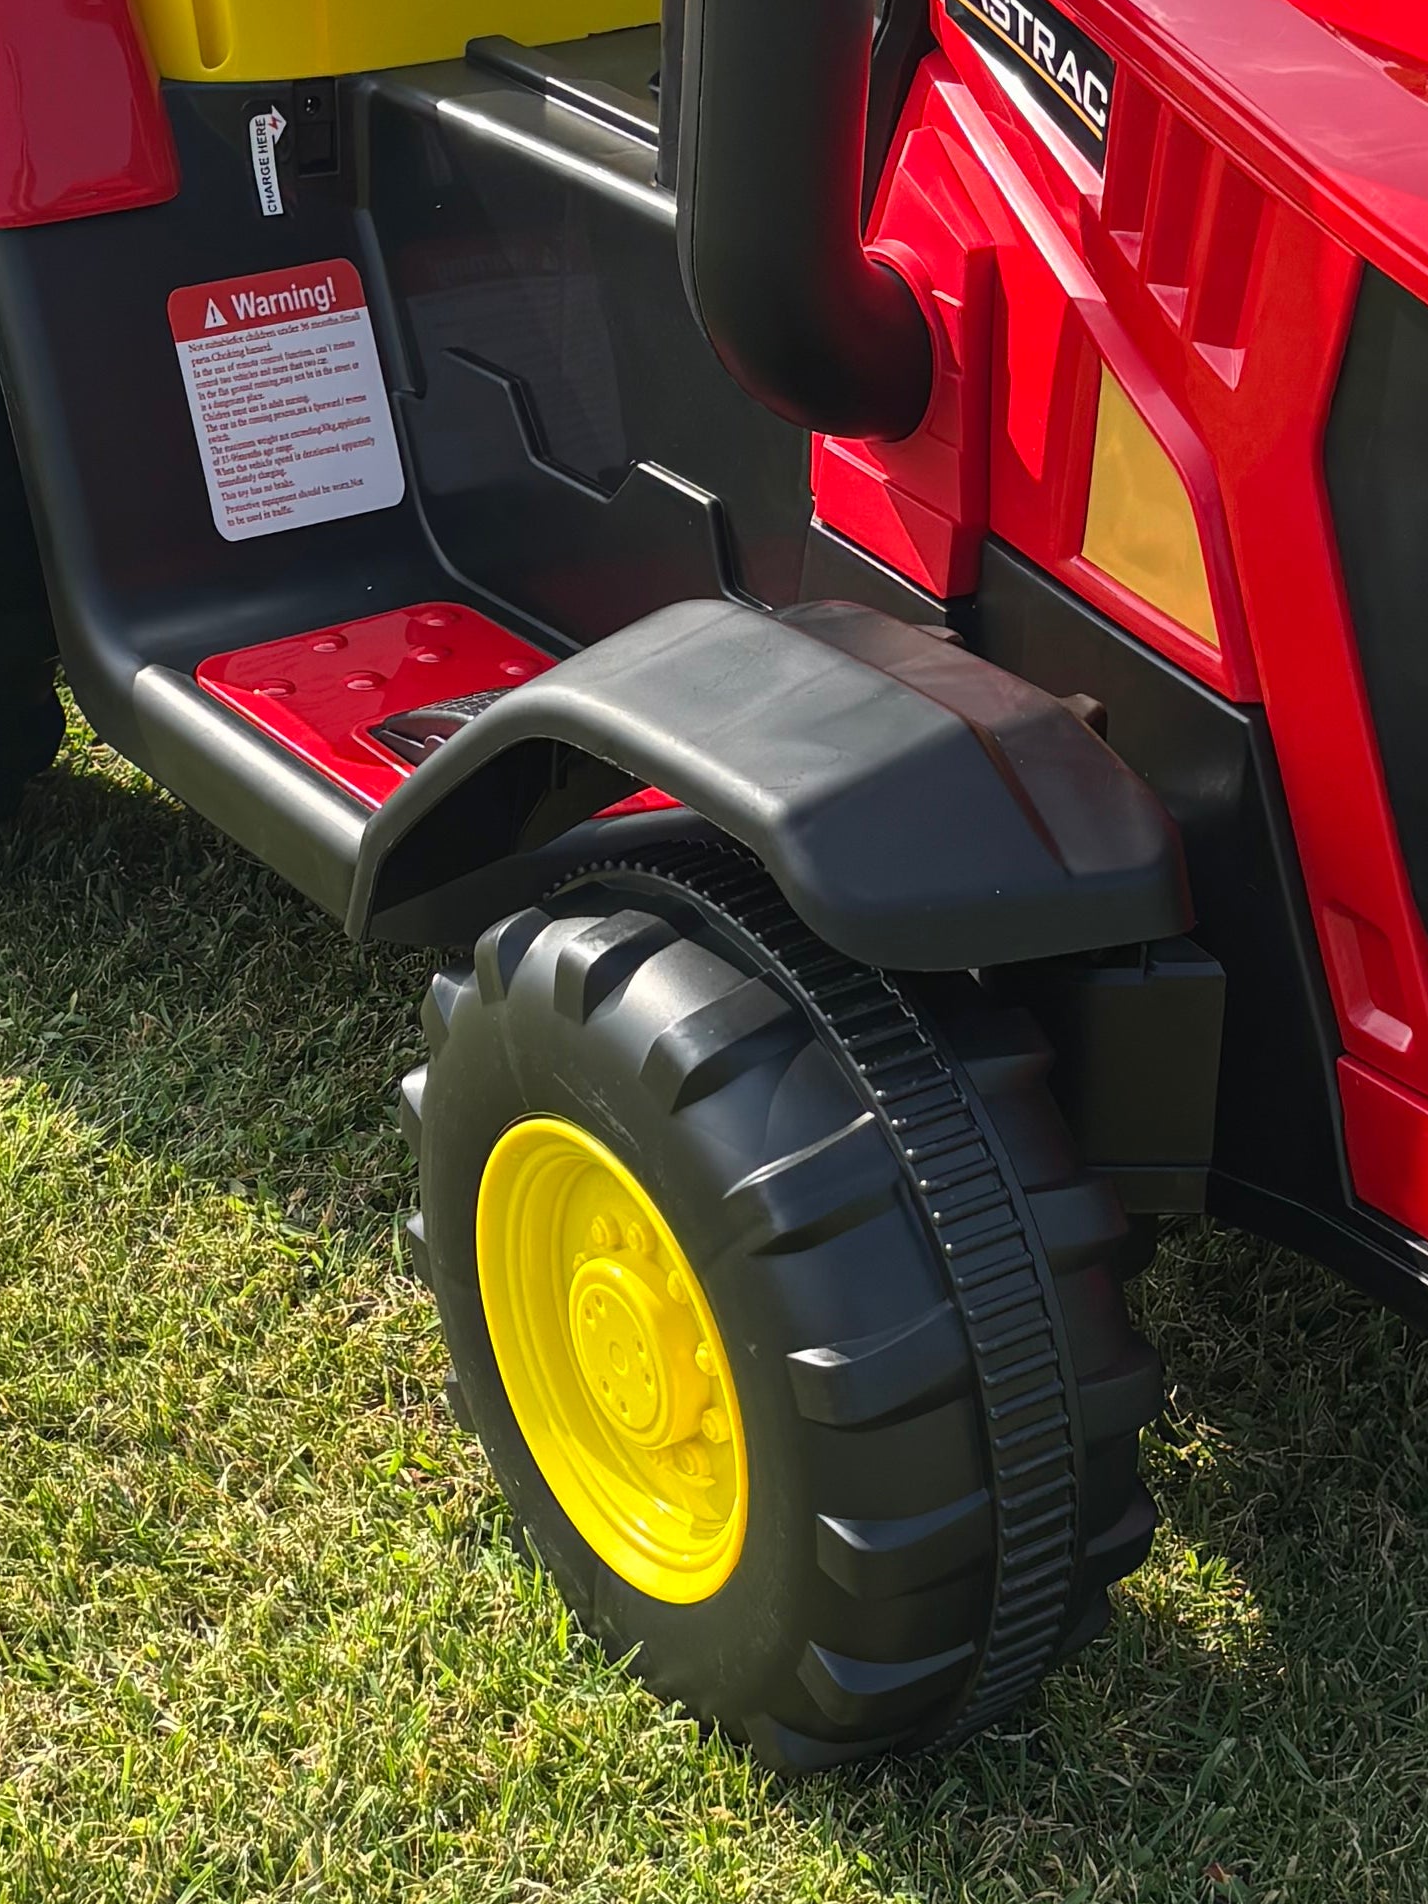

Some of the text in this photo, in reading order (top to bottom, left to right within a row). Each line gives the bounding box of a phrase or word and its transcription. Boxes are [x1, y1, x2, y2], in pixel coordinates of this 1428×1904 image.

[254, 116, 278, 213] CHARGE HERE
[230, 277, 337, 321] Warning!
